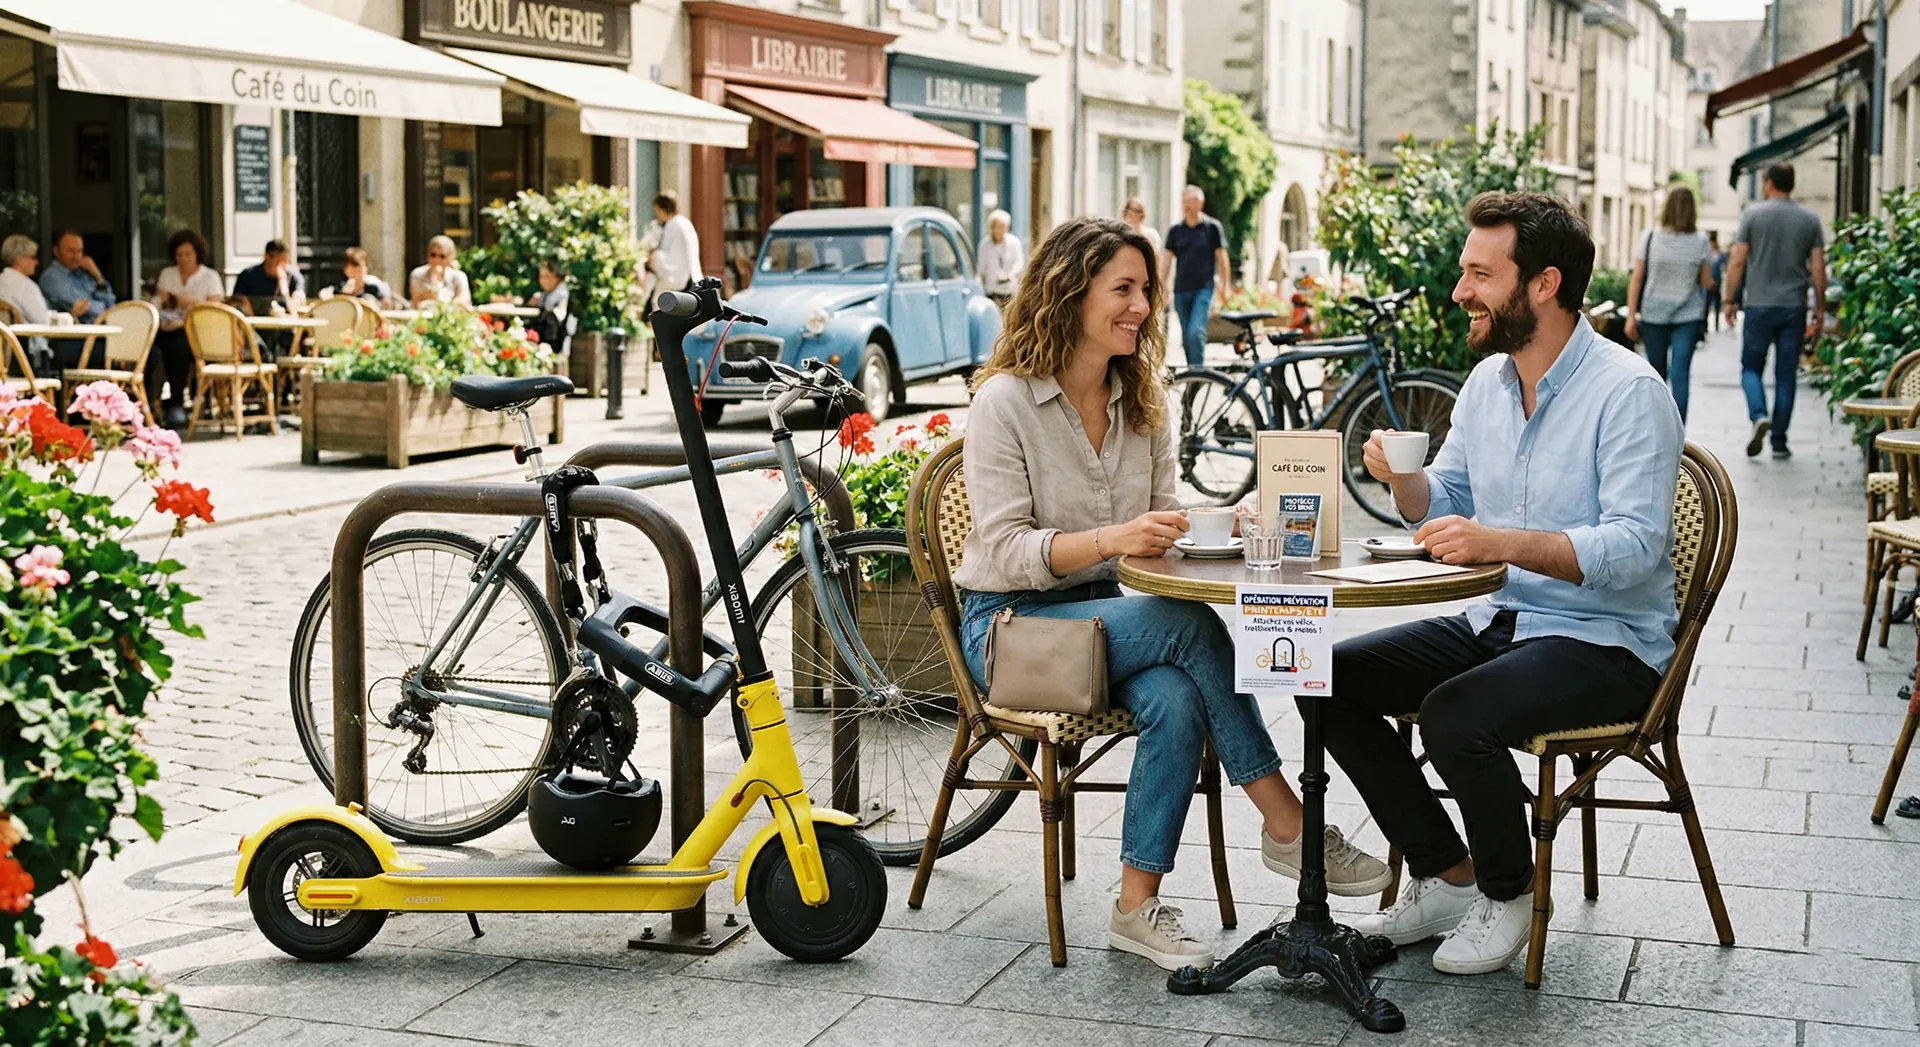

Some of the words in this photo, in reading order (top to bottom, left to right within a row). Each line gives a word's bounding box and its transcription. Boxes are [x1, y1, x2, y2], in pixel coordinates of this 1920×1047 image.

[454, 0, 605, 47] BOULANGERIE
[751, 36, 847, 80] LIBRAIRIE
[232, 68, 284, 100] Café
[294, 74, 320, 103] du
[329, 78, 376, 108] Coin
[1272, 463, 1291, 473] CAFÉ
[1293, 464, 1304, 473] DU
[1305, 465, 1326, 473] COIN
[727, 583, 746, 624] xiaomi
[647, 664, 674, 683] ABUS
